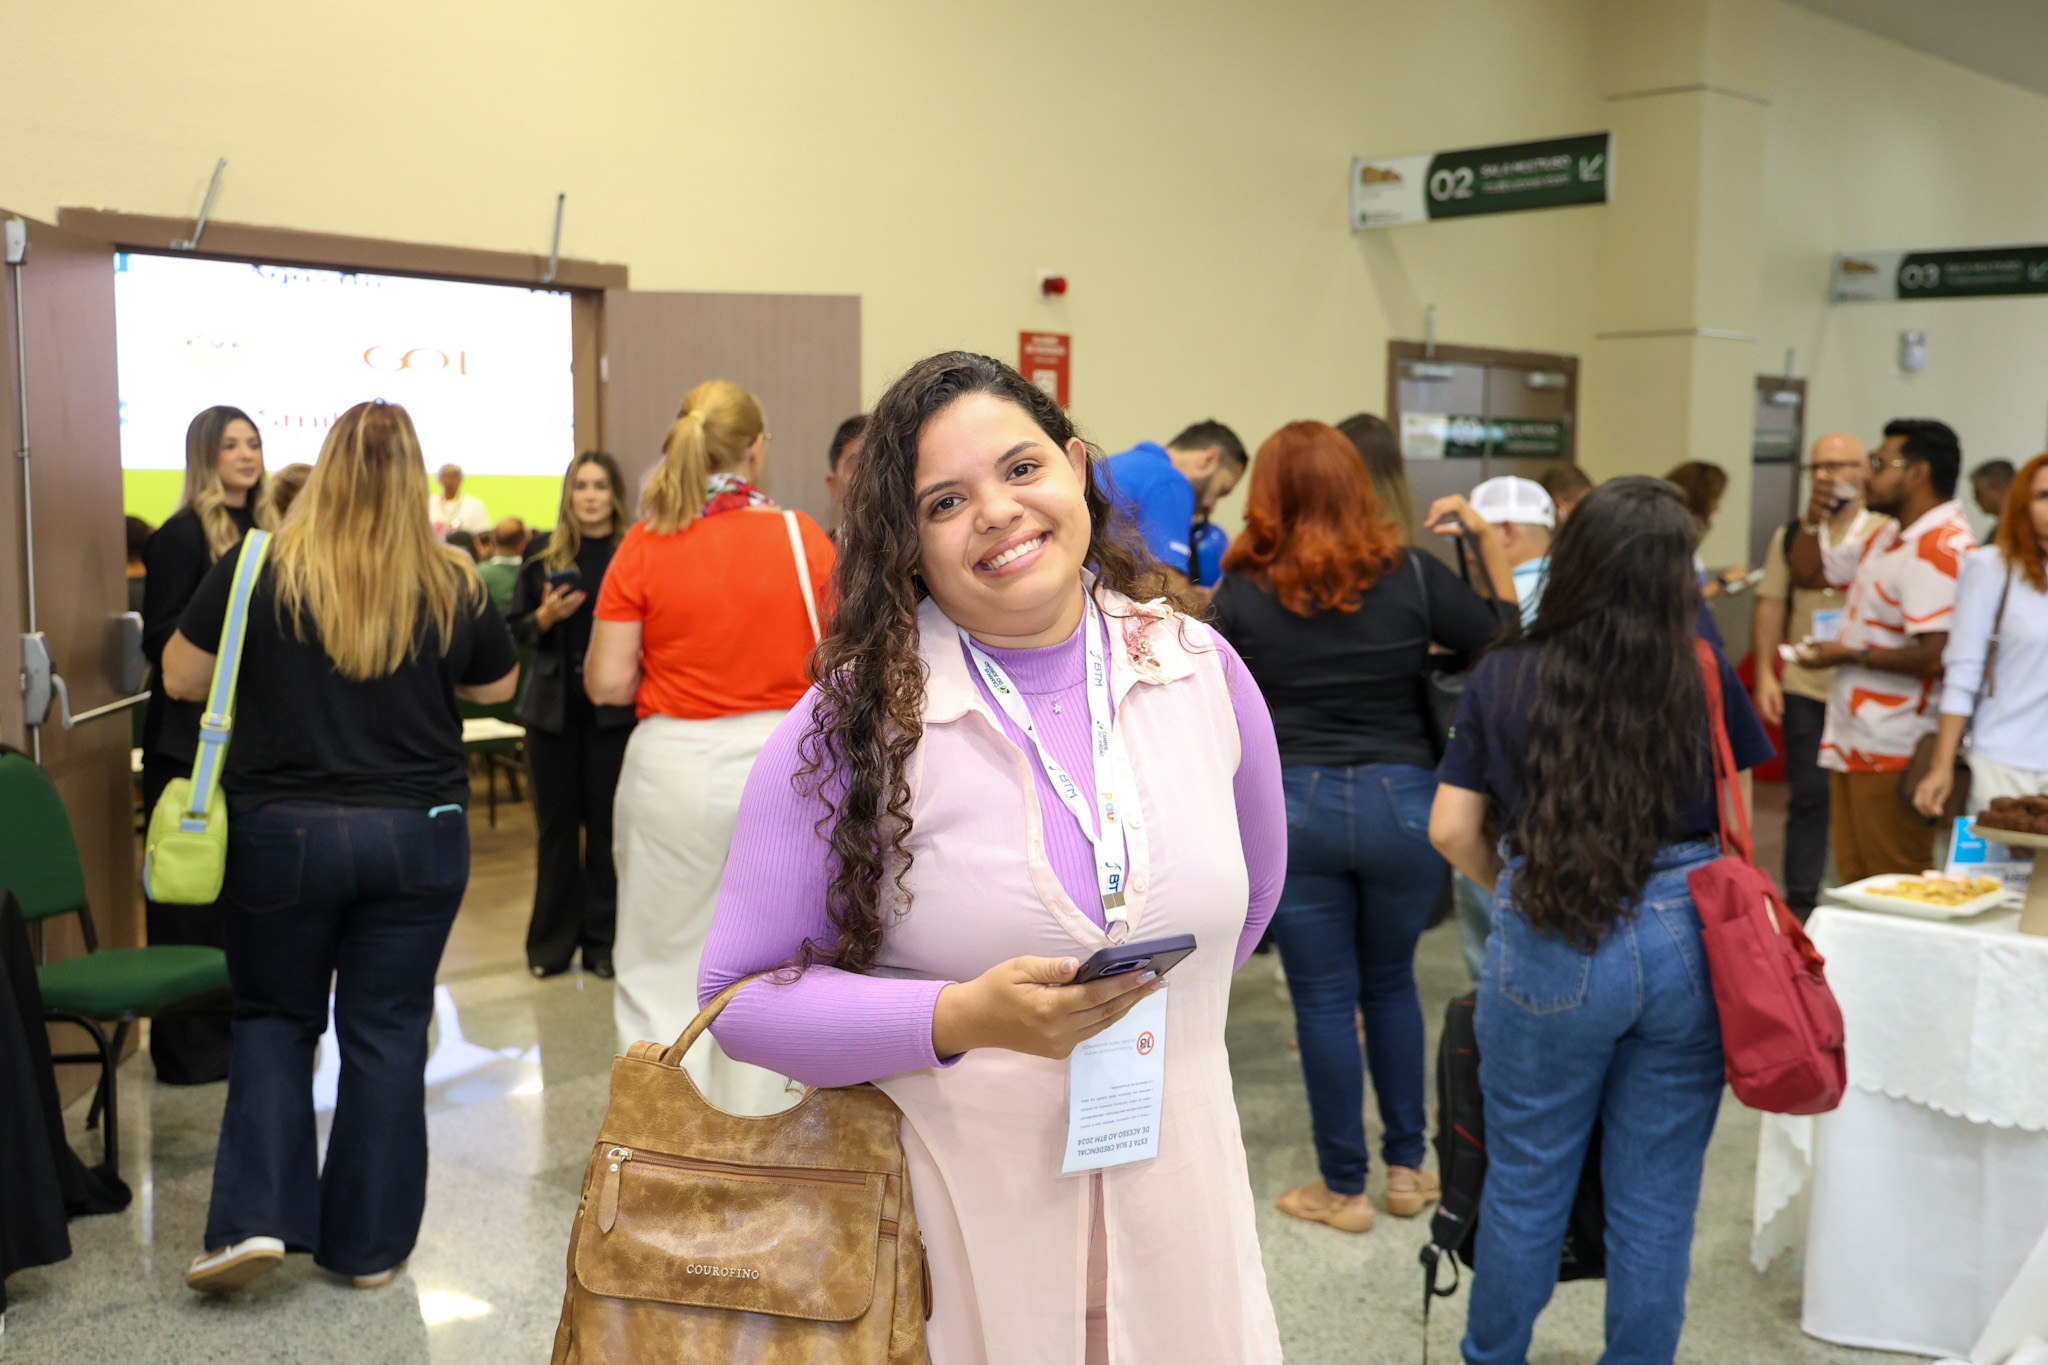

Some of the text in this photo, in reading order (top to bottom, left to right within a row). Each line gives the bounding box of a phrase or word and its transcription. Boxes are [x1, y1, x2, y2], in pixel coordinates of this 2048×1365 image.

[1429, 166, 1475, 201] 02
[1094, 661, 1103, 687] BTM
[1058, 774, 1078, 799] BTM
[1078, 1126, 1150, 1146] DE ACESSO AO BTM 2024
[1134, 1137, 1148, 1146] ESTA
[1077, 1144, 1115, 1156] CREDENCIAL
[1116, 1141, 1128, 1150] SUA
[686, 1264, 760, 1280] COUROFINO
